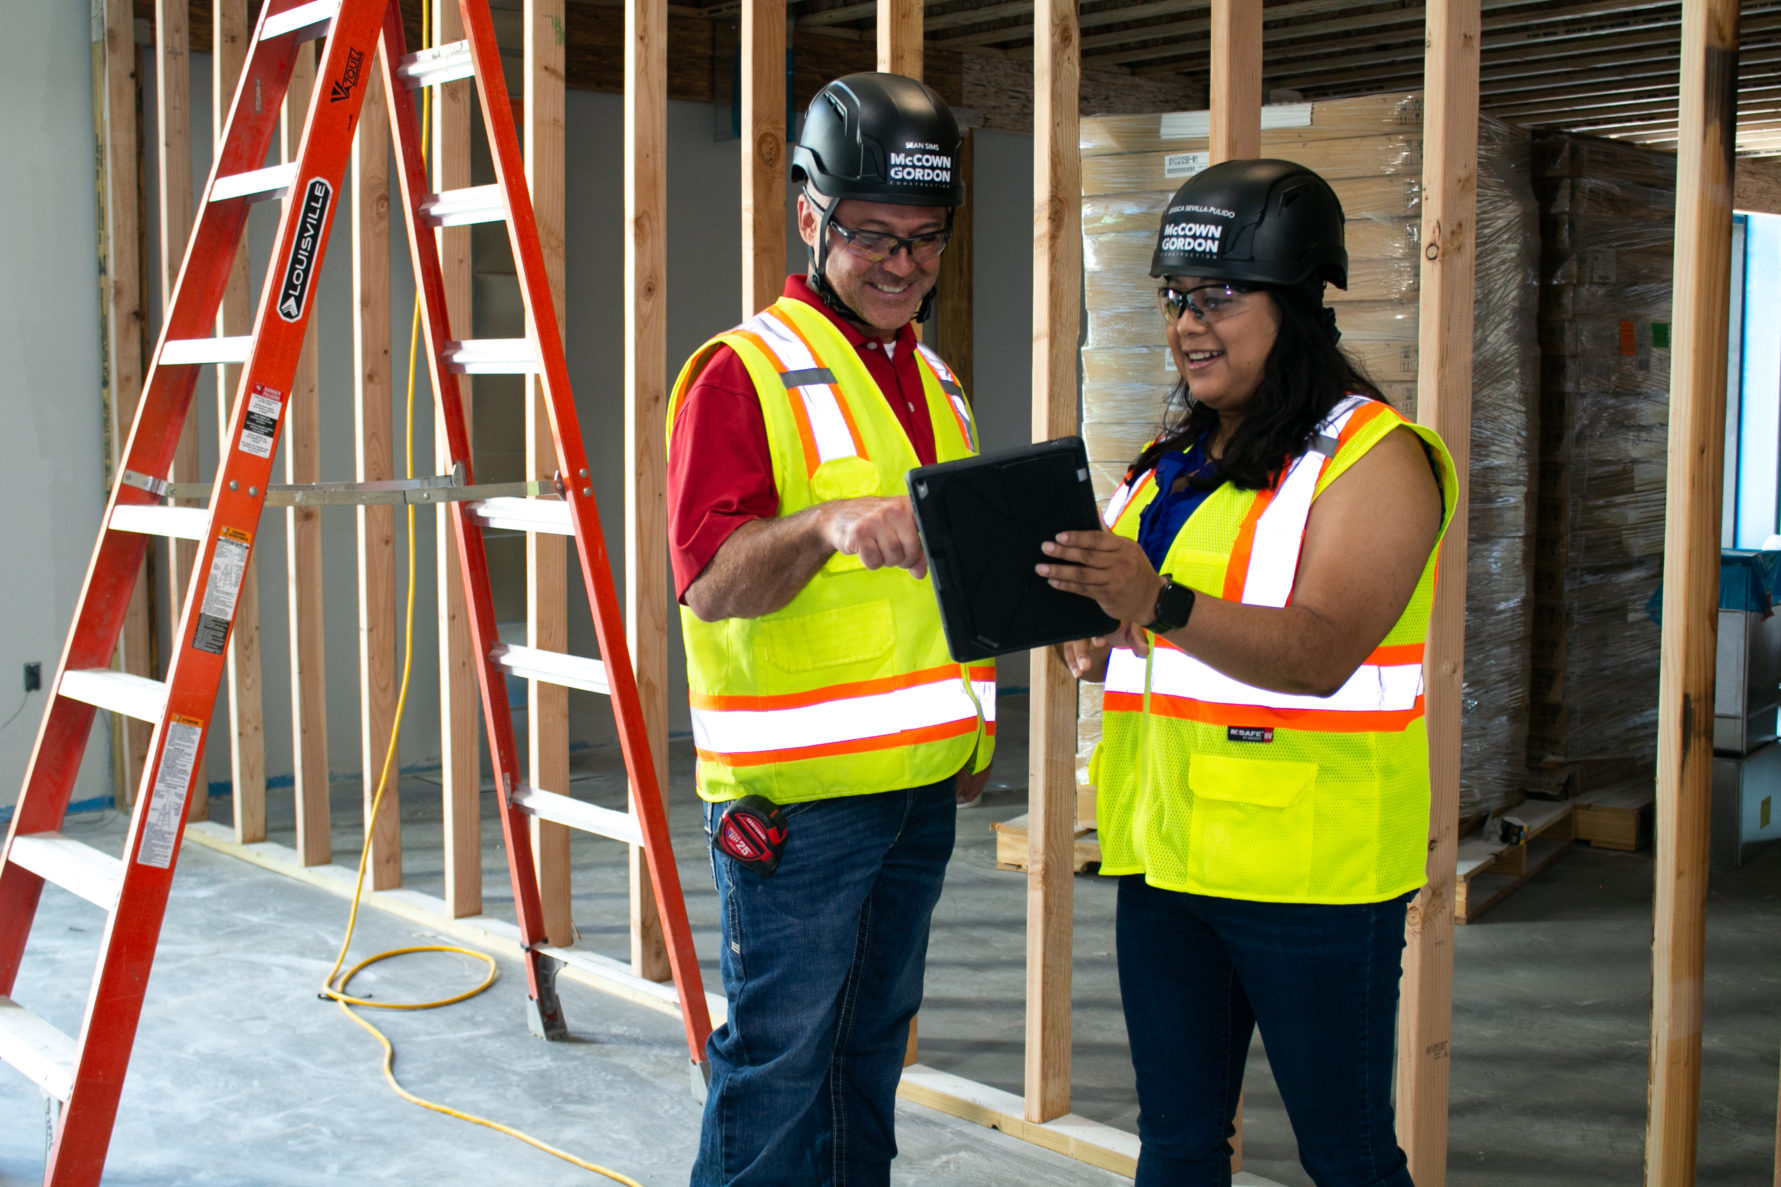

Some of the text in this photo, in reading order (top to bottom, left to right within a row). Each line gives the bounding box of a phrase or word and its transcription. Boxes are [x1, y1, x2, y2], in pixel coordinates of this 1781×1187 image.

[905, 141, 939, 151] SEAN SIMS
[890, 152, 951, 169] McCOWN
[890, 166, 951, 182] GORDON
[1164, 222, 1222, 239] McCOWN
[288, 182, 326, 296] LOUISVILLE
[1161, 237, 1219, 253] GORDON
[736, 841, 751, 856] 25
